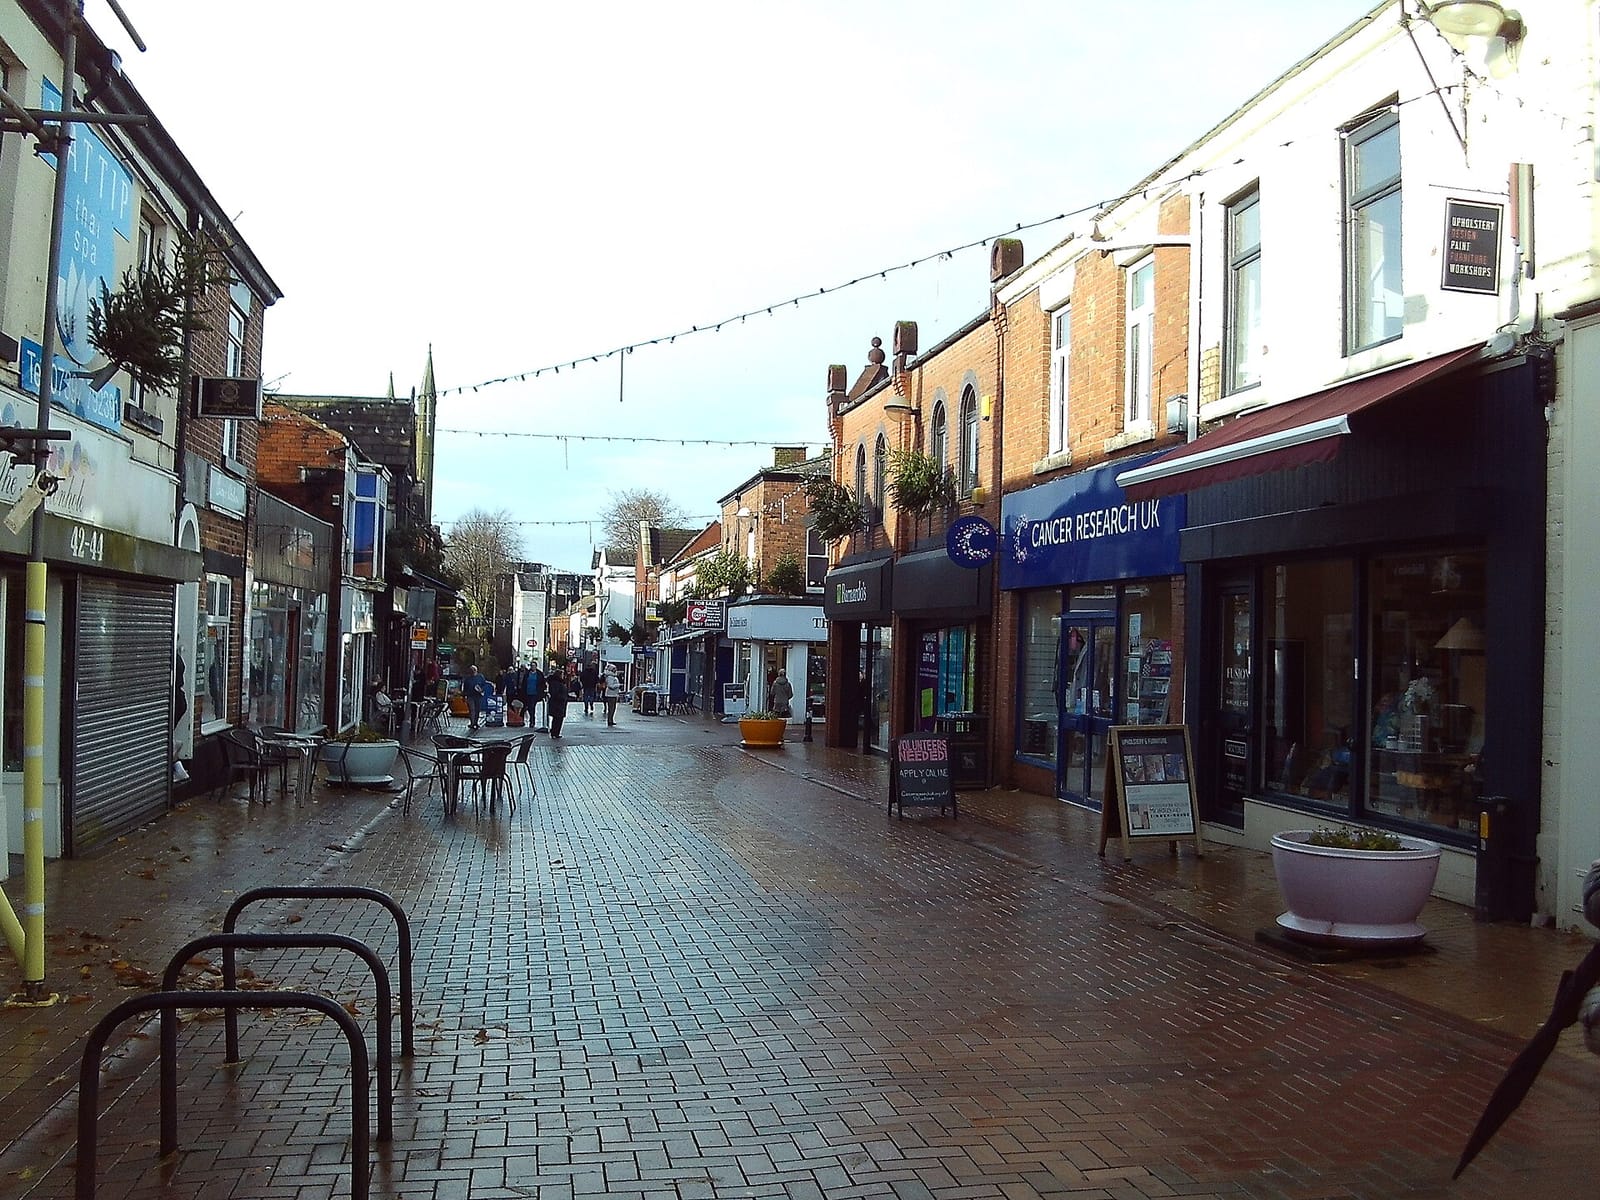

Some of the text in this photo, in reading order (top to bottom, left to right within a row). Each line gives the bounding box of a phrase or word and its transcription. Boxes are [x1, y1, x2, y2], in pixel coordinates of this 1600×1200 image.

[1451, 216, 1495, 231] UPHOLSTERY
[1451, 228, 1477, 240] DESIGN
[73, 230, 97, 266] spa
[1450, 240, 1471, 251] PAINT
[1450, 252, 1488, 264] FURNITURE
[1449, 263, 1492, 277] WORKSHOPS
[1031, 499, 1160, 548] CANCER RESEARCH UK
[70, 526, 104, 561] 42-44
[898, 739, 948, 752] VOLUNTEERS
[898, 750, 949, 762] NEEDED!
[899, 768, 949, 778] APPLY ONLINE
